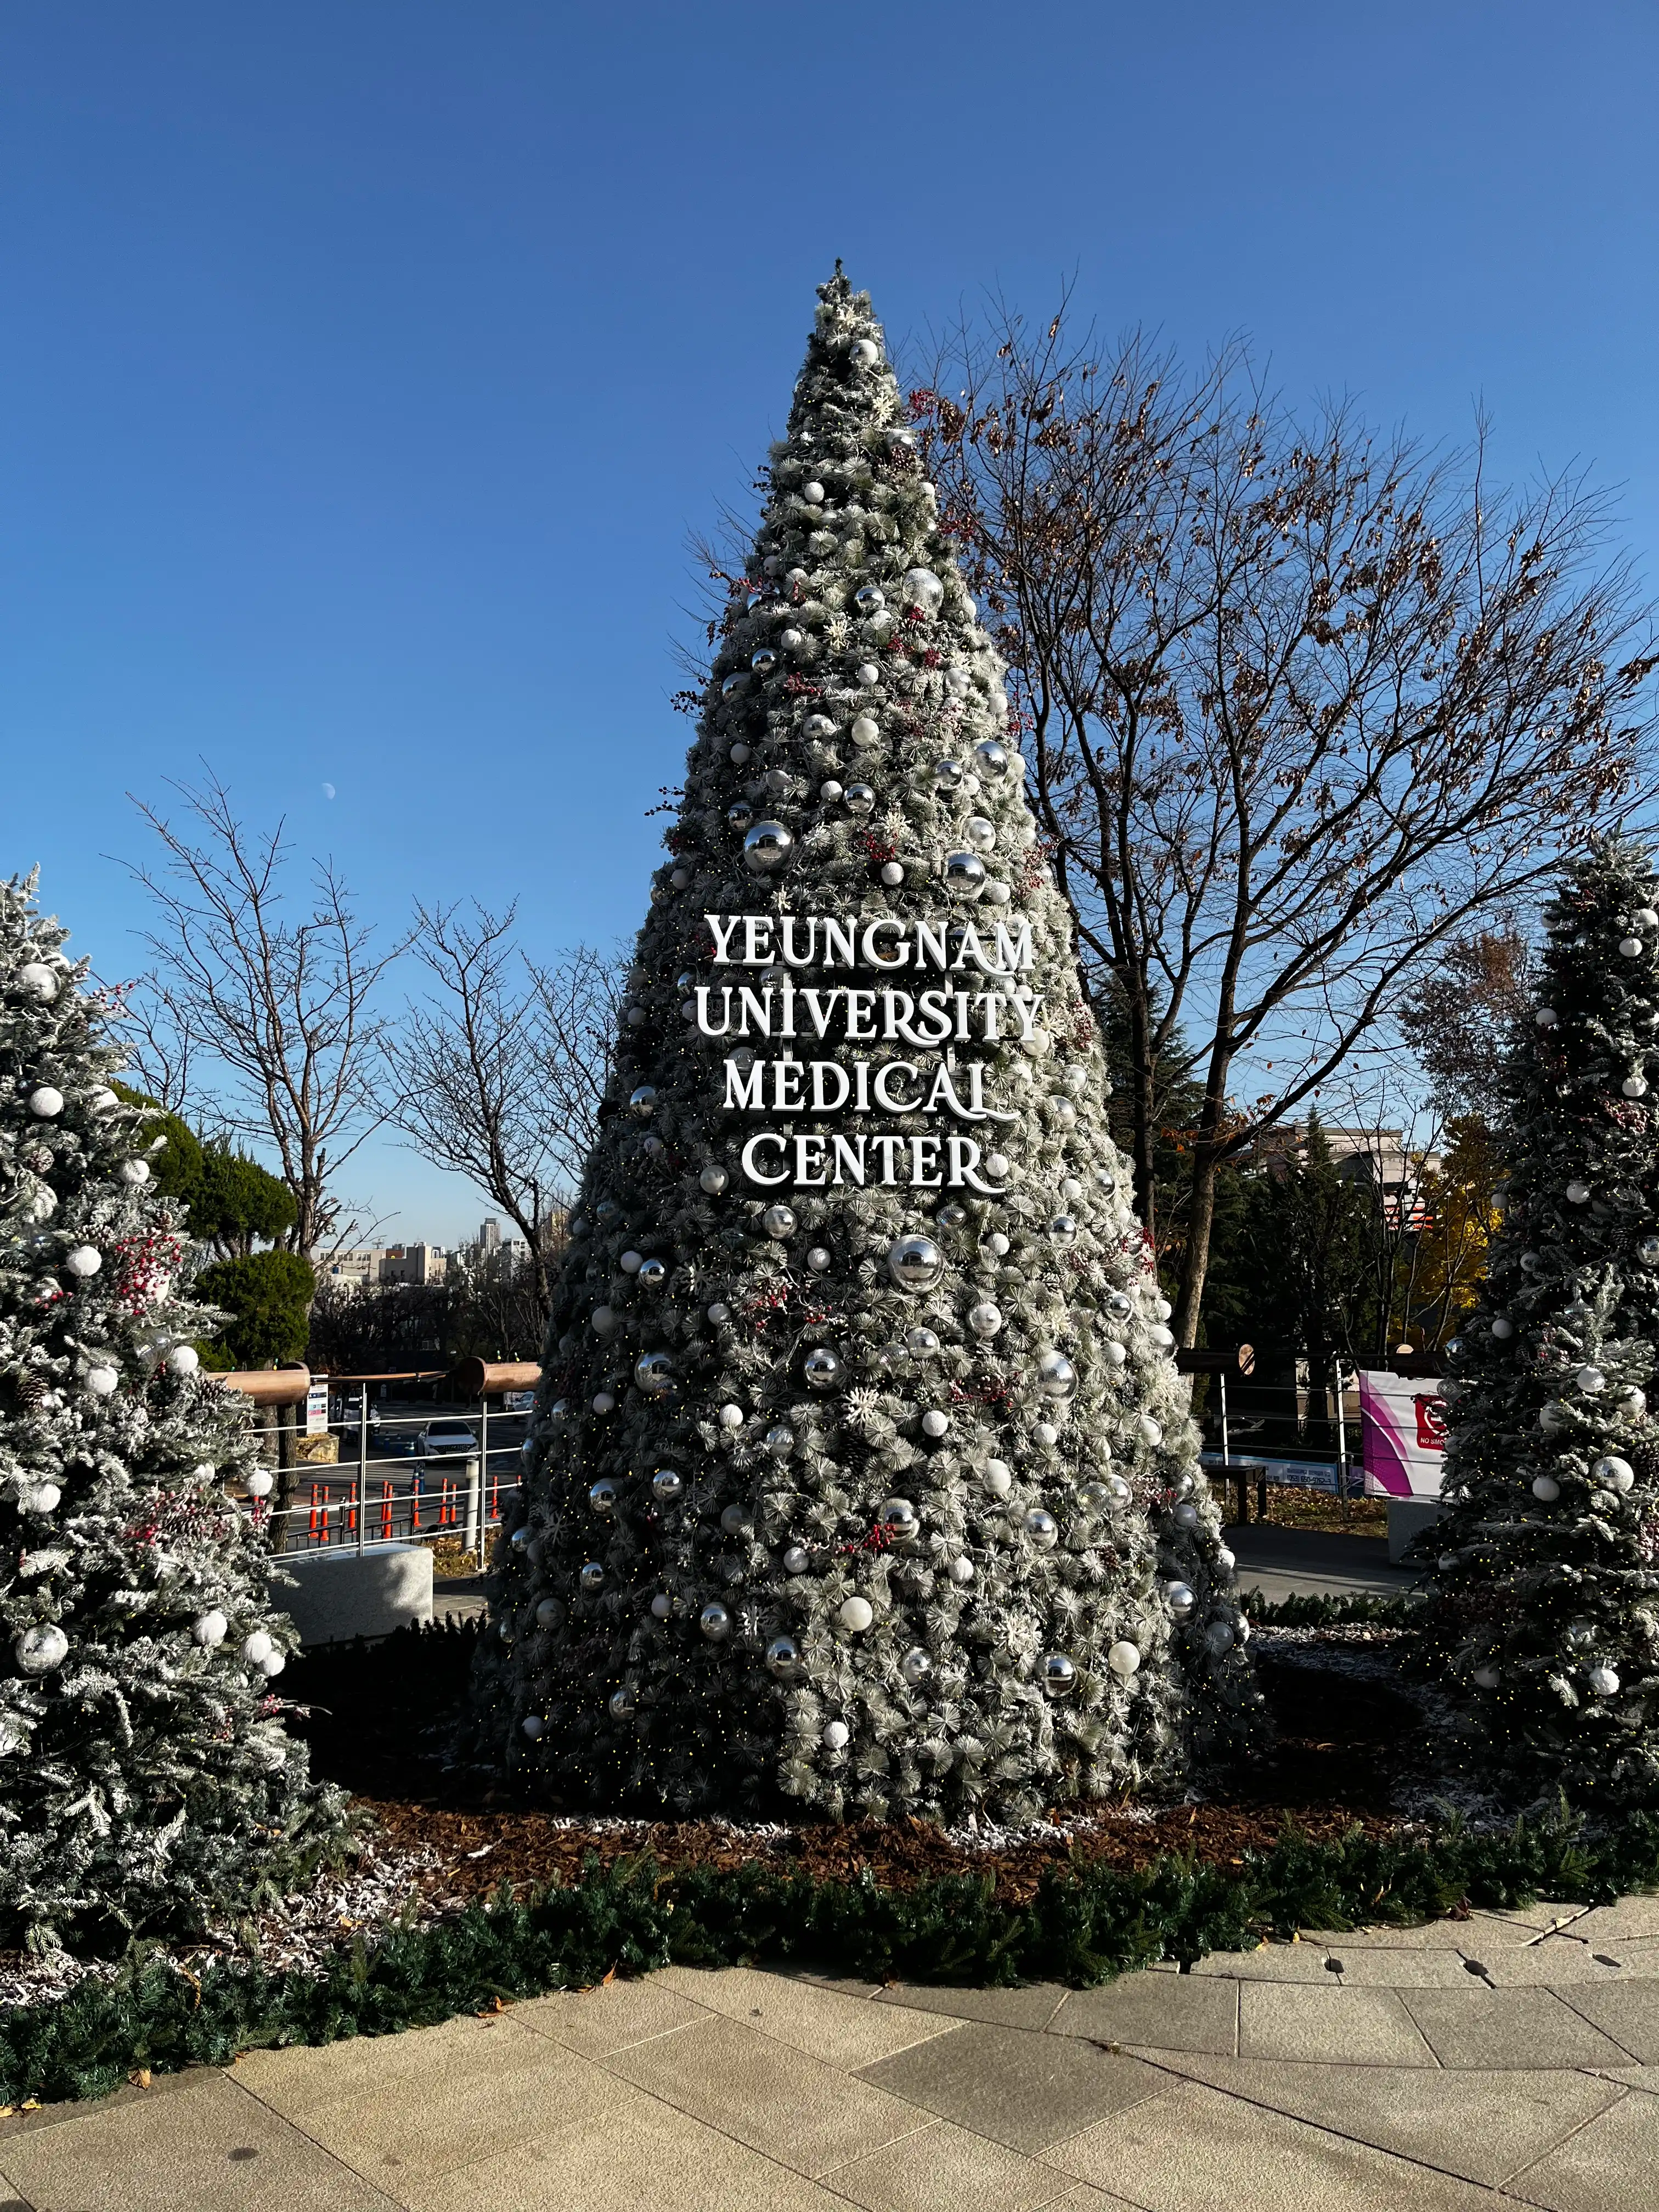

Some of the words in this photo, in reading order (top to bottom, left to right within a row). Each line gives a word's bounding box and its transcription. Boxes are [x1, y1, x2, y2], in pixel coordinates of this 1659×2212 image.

[704, 914, 1037, 978] YEUNGNAM
[695, 986, 1043, 1048] UNIVERSITY
[723, 1059, 1020, 1121] MEDICAL
[742, 1133, 1006, 1194] CENTER
